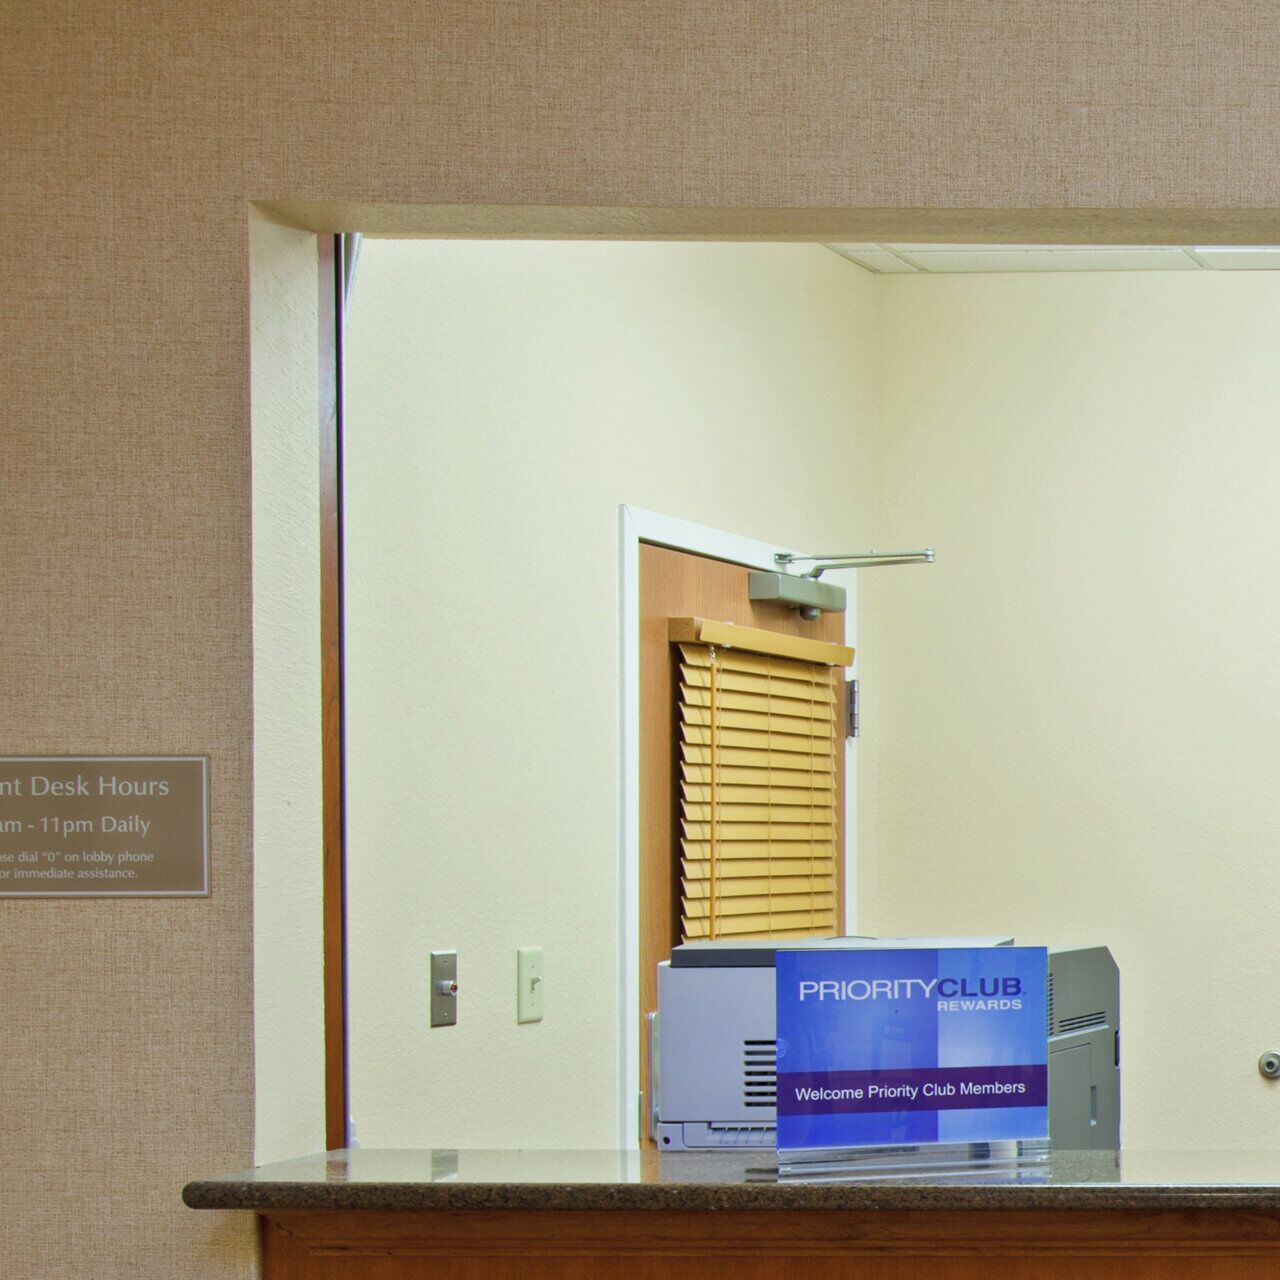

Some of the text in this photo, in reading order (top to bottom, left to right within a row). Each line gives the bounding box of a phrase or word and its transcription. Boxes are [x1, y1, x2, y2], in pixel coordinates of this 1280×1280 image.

[31, 774, 89, 797] Desk
[99, 776, 170, 797] Hours
[40, 816, 93, 838] 11pm
[101, 814, 151, 838] Daily
[18, 851, 38, 862] dial
[64, 854, 79, 862] on
[83, 851, 114, 865] lobby
[118, 851, 153, 865] phone
[15, 867, 74, 880] immediate
[77, 867, 138, 880] assistance.
[937, 999, 1023, 1013] REWARDS
[794, 1080, 1027, 1102] Welcome Priority Club Members
